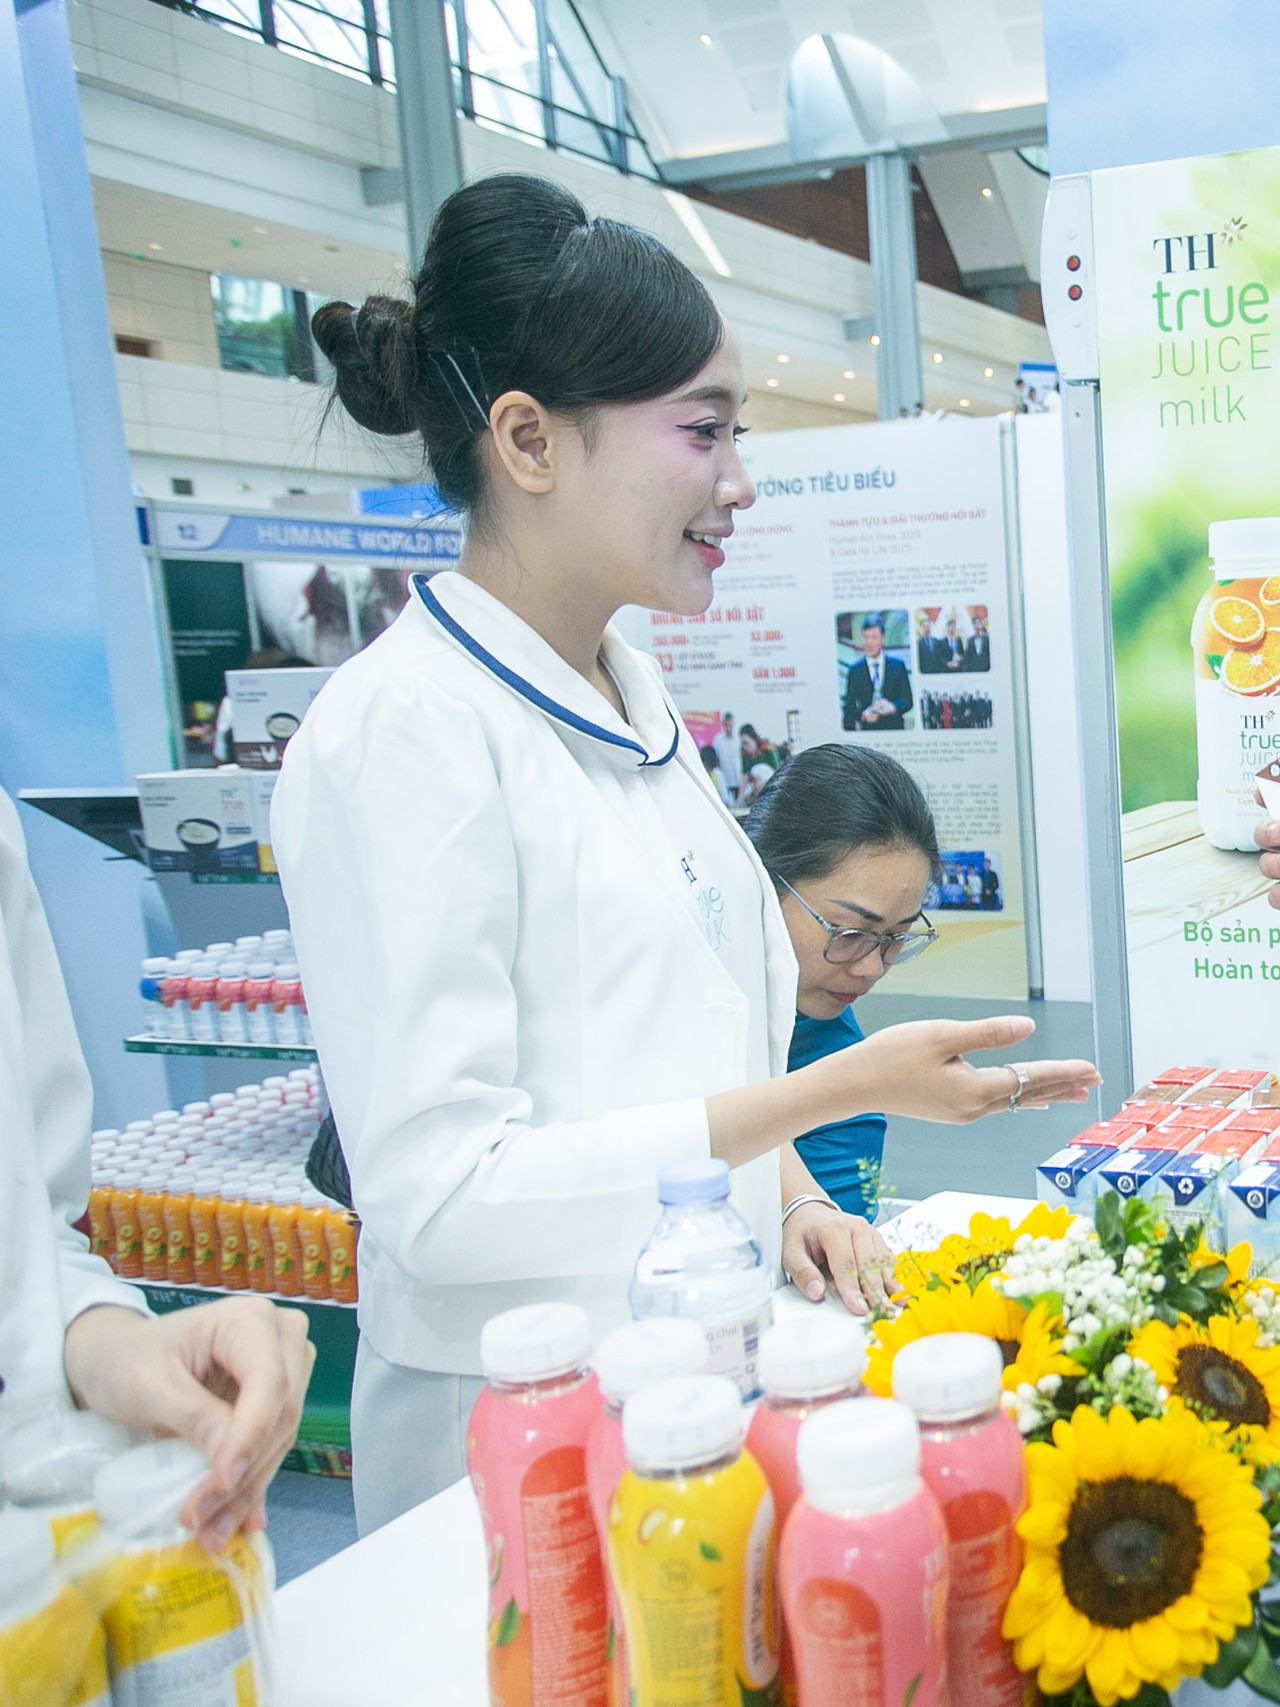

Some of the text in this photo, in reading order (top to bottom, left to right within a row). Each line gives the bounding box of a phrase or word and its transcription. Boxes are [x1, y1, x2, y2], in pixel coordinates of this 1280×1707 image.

[1153, 232, 1217, 274] TH
[1152, 280, 1269, 332] true
[1152, 333, 1271, 379] JUICE
[1160, 385, 1246, 428] milk
[808, 470, 849, 492] TIÊU
[256, 525, 460, 555] HUMANE WORLD FO
[1240, 715, 1264, 729] TH
[1183, 921, 1213, 946] Bộ
[1220, 919, 1261, 943] sản
[1194, 957, 1253, 979] Hoàn
